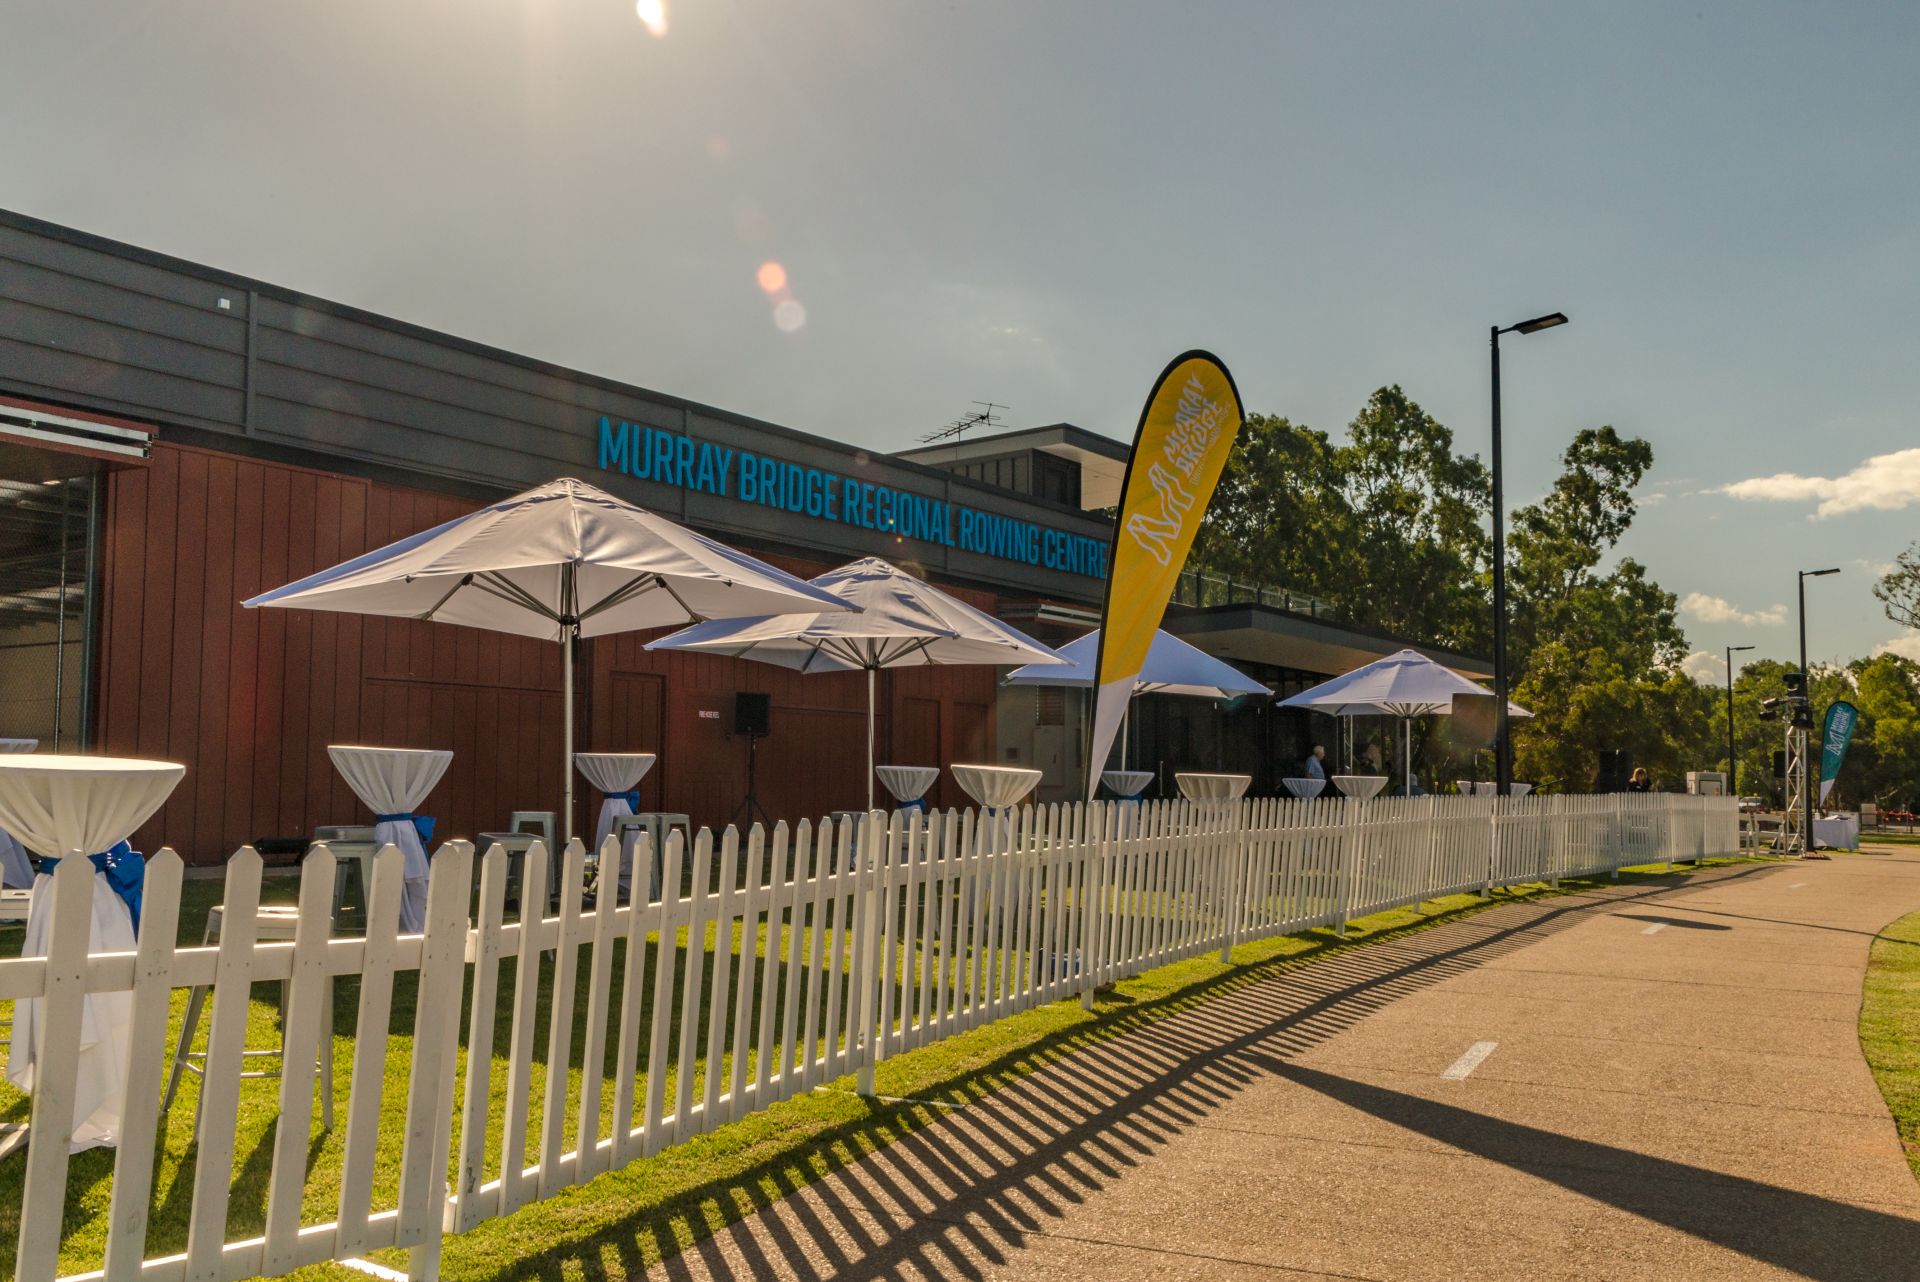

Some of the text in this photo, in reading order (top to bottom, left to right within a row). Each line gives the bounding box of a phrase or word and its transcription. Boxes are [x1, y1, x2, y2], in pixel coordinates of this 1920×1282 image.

[1162, 371, 1205, 462] MURRAY
[1175, 398, 1223, 478] BRIDGE
[597, 416, 1109, 580] MURRAY BRIDGE REGIONAL ROWING CENTRE
